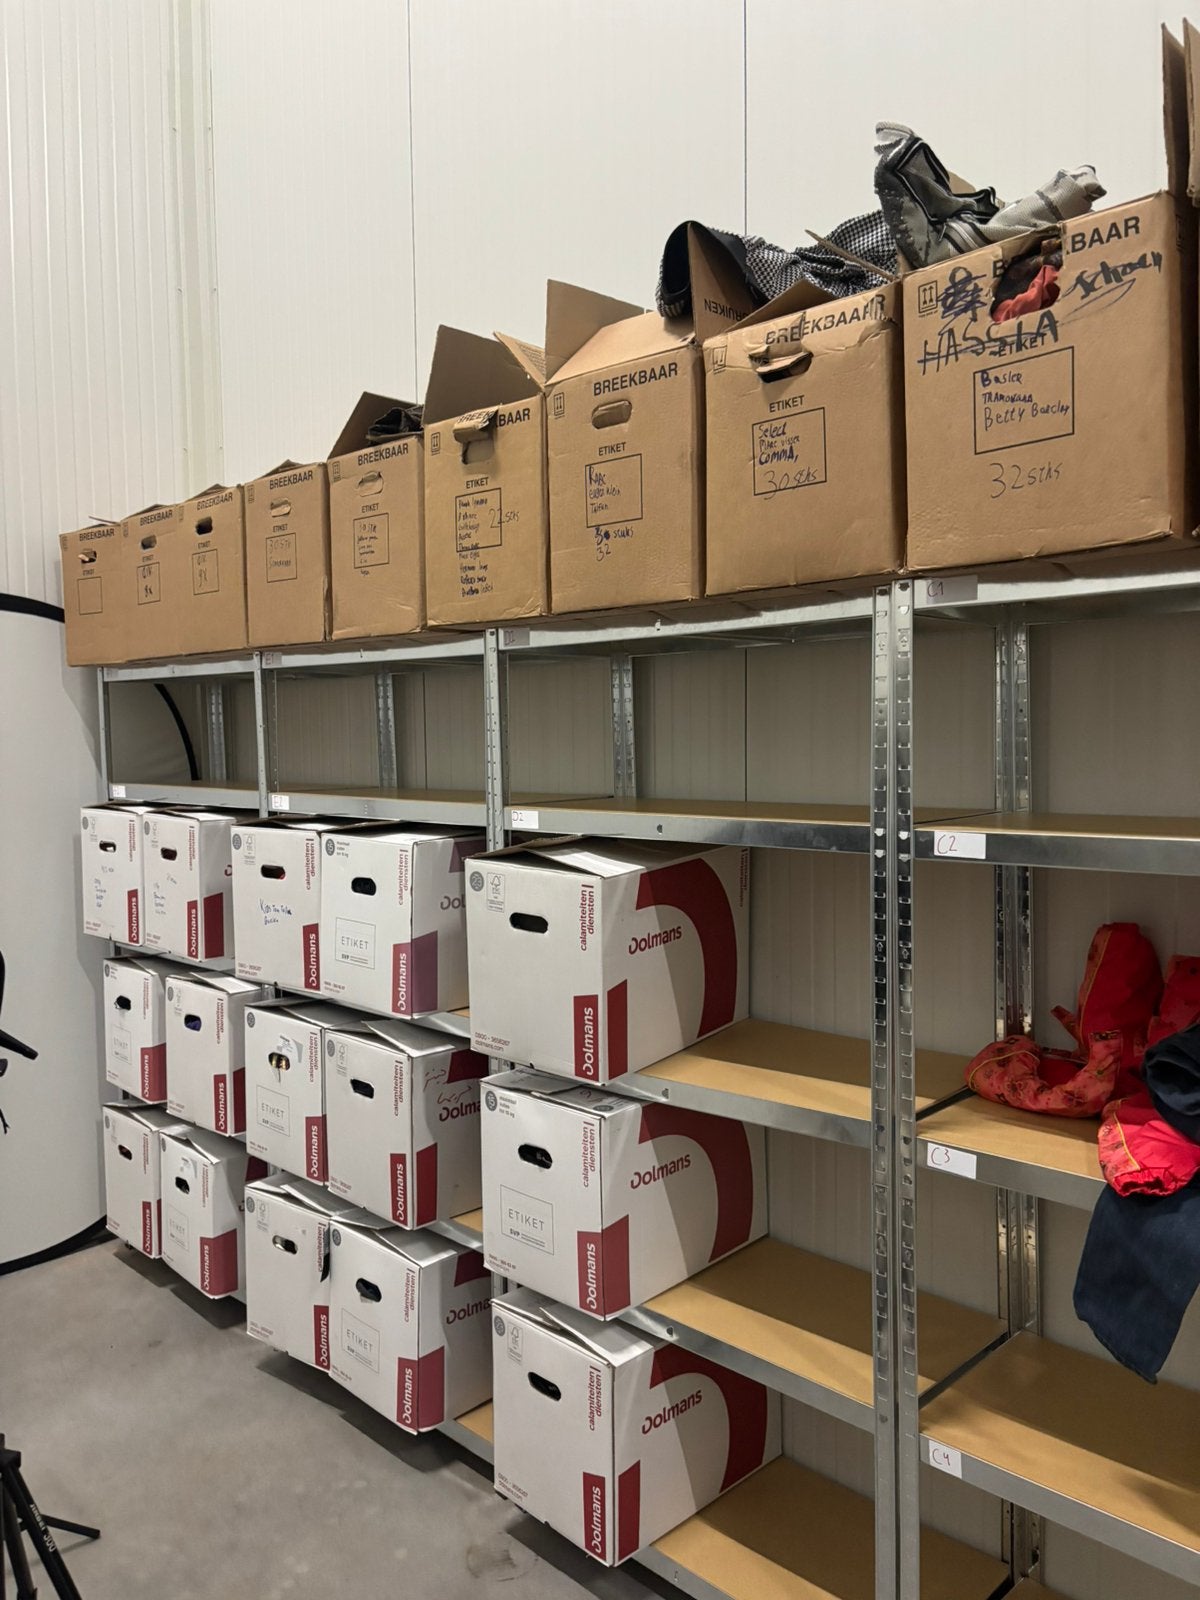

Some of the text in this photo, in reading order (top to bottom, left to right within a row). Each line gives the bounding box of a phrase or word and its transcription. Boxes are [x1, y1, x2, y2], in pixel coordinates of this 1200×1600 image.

[765, 294, 886, 346] BREEKBAAR
[593, 362, 678, 396] BREEKBAAR
[769, 395, 805, 413] ETIKET
[357, 442, 409, 466] BREEKBAAR
[598, 441, 626, 457] ETIKET
[269, 470, 313, 490] BREEKBAAR
[465, 477, 489, 489] ETIKET
[197, 492, 233, 511] BREEKBAAR
[361, 502, 380, 513] ETIKET
[140, 509, 173, 526] BREEKBAAR
[79, 528, 115, 542] BREEKBAAR
[927, 582, 944, 597] C1
[937, 834, 957, 854] C2
[579, 889, 587, 952] calamiteiten
[587, 890, 595, 935] diensten
[341, 935, 369, 950] ETIKET
[628, 925, 682, 955] Dolmans
[309, 932, 317, 987] Dolmans
[397, 952, 406, 1012] Dolmans
[582, 1006, 594, 1076] Dolmans
[216, 1082, 225, 1130] Dolmans
[261, 1102, 285, 1120] ETIKET
[310, 1125, 318, 1177] Dolmans
[588, 1128, 596, 1173] diensten
[931, 1147, 950, 1166] C3
[630, 1153, 691, 1190] Dolmans
[396, 1163, 404, 1221] Dolmans
[508, 1208, 546, 1232] ETIKET
[585, 1242, 596, 1310] Dolmans
[320, 1314, 328, 1367] Dolmans
[346, 1329, 373, 1353] ETIKET
[402, 1367, 413, 1425] Dolmans
[641, 1389, 703, 1435] Dolmans
[932, 1448, 950, 1466] C4
[591, 1485, 602, 1554] Dolmans
